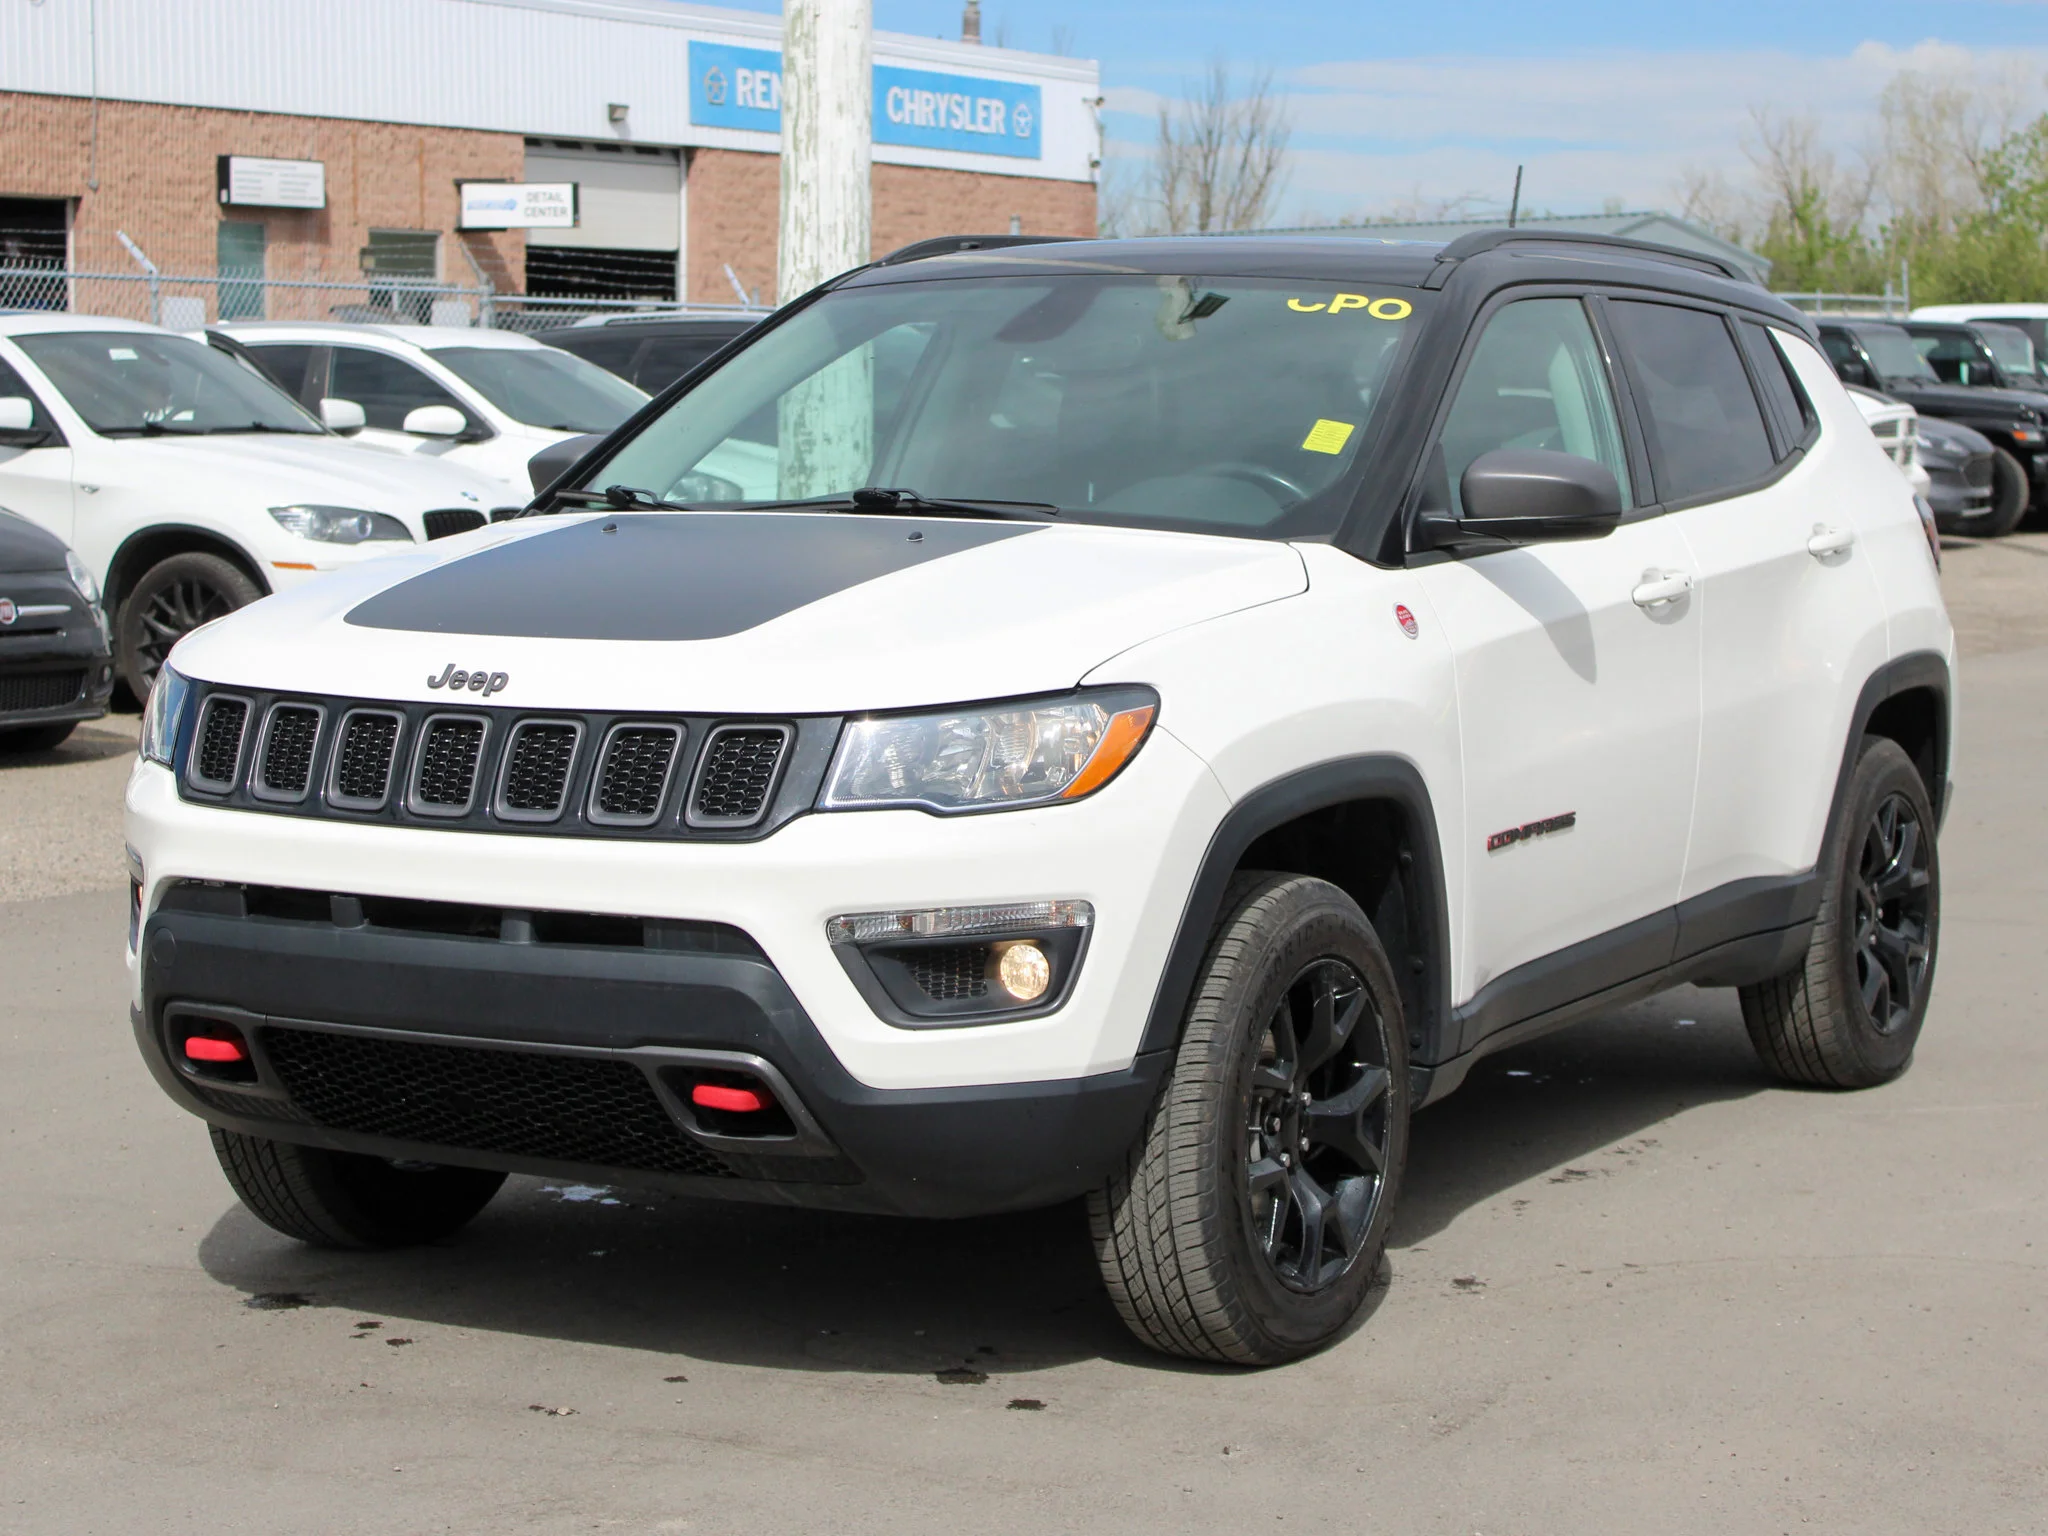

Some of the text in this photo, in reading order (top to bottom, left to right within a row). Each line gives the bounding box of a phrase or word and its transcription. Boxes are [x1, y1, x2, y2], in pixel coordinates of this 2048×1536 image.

[886, 85, 1006, 135] CHRYSLER
[526, 191, 565, 203] DETAIL
[524, 206, 569, 217] CENTER
[427, 663, 509, 697] Jeep
